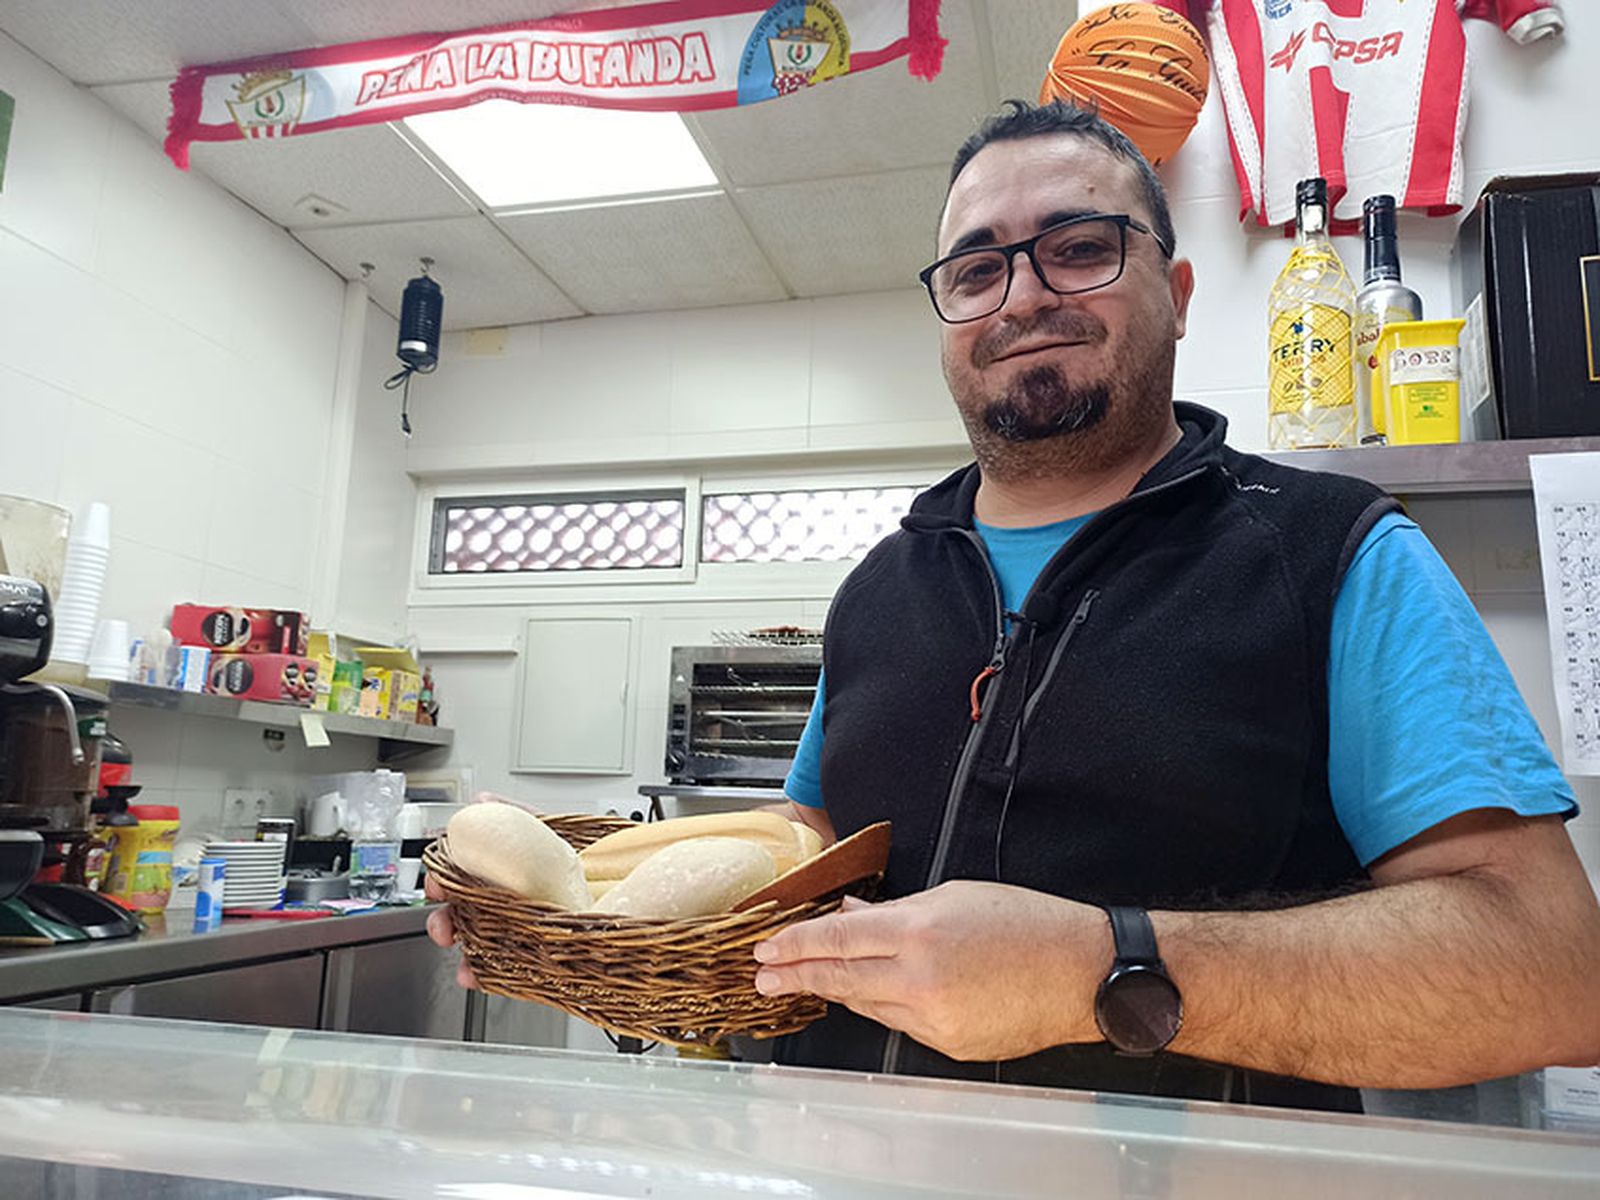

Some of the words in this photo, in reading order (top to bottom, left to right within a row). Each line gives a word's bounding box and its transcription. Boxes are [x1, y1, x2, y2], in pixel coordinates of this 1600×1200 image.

[355, 47, 457, 106] PEÑA
[465, 42, 519, 84] LA
[528, 32, 716, 88] BUFANDA
[1312, 20, 1404, 64] CPSA
